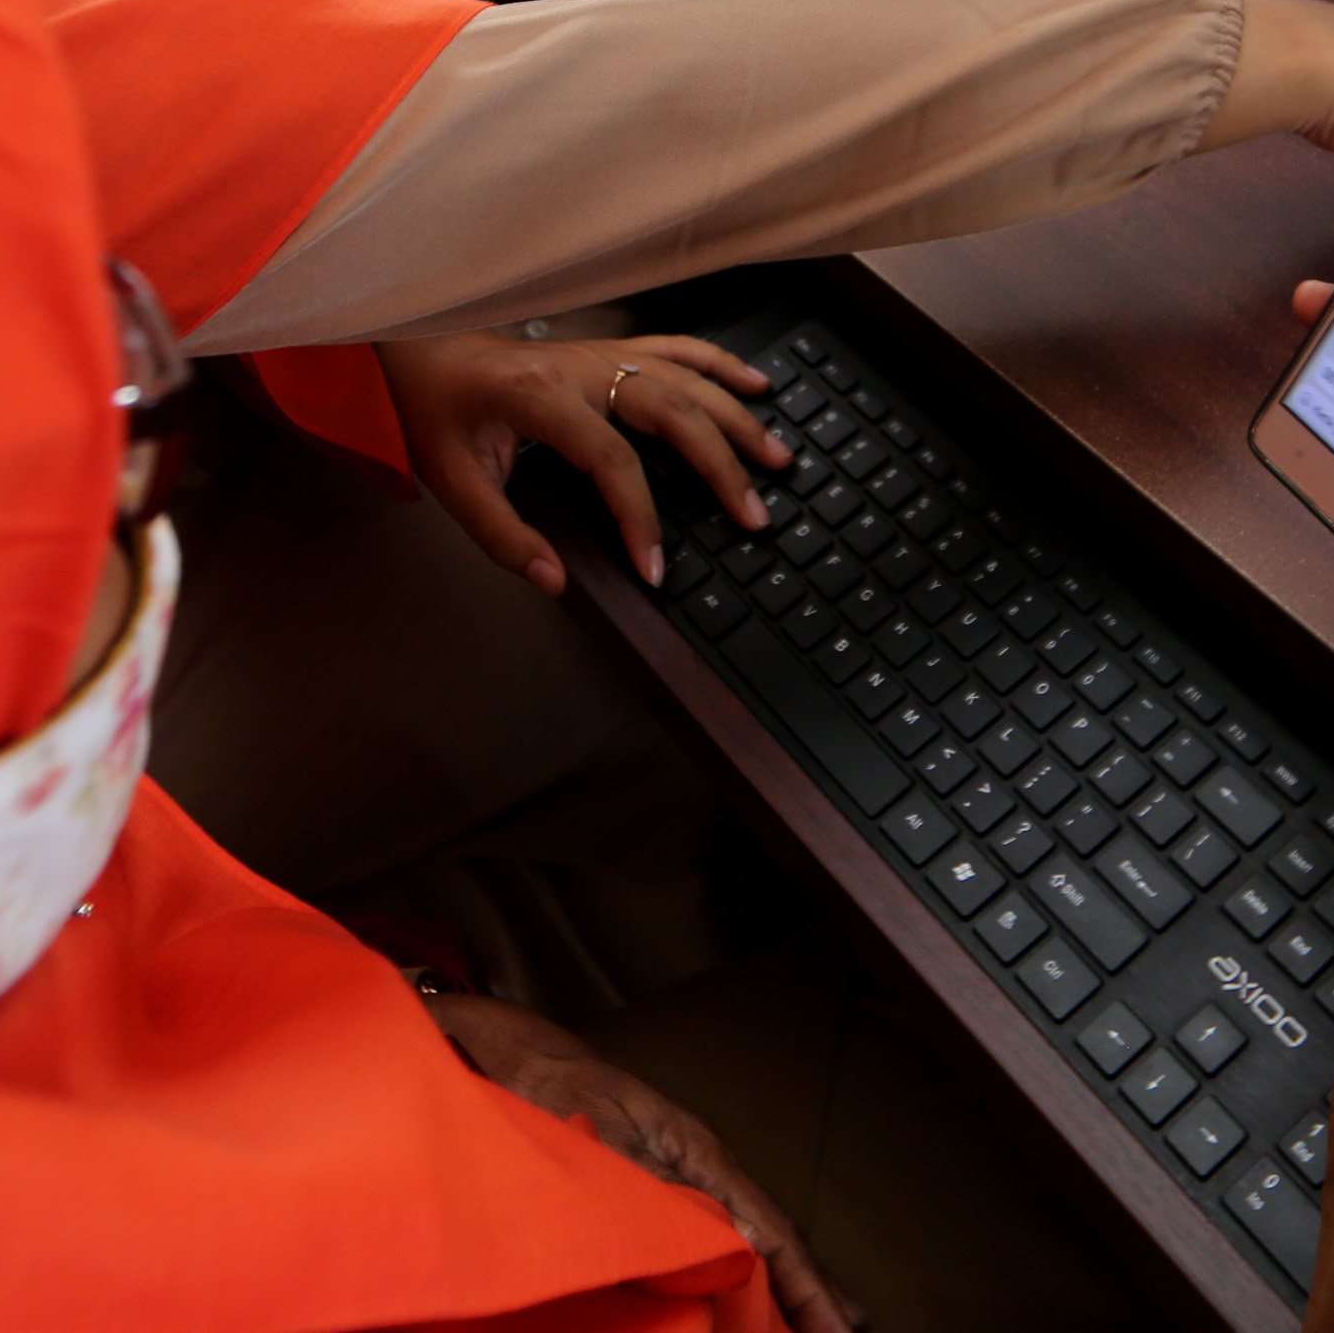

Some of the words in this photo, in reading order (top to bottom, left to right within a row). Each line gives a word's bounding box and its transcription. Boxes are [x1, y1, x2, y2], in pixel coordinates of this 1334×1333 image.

[799, 456, 816, 470] W
[828, 485, 844, 499] E
[860, 515, 875, 529] R
[795, 524, 811, 537] D
[739, 542, 755, 555] X
[895, 547, 909, 559] T
[826, 555, 842, 566] F
[770, 573, 786, 585] C
[928, 578, 942, 592] Y
[859, 589, 875, 602] G
[803, 604, 818, 617] V
[962, 612, 978, 626] U
[893, 621, 910, 636] H
[833, 638, 850, 653] B
[997, 646, 1010, 657] I
[926, 657, 942, 667] J
[1143, 648, 1161, 664] F10
[868, 672, 886, 687] N
[1034, 681, 1050, 695] O
[1184, 686, 1202, 702] F11
[965, 691, 980, 706] K
[902, 709, 921, 726] M
[1071, 717, 1089, 729] P
[1000, 727, 1014, 742] L
[1227, 724, 1248, 742] F12
[905, 813, 924, 830] Alt
[1287, 849, 1316, 873] Insert
[1118, 860, 1143, 882] Enter
[1060, 882, 1086, 907] Shift
[1242, 889, 1269, 916] Delete
[1288, 935, 1314, 957] End
[1042, 959, 1066, 981] Ctrl
[1207, 956, 1308, 1048] axioo
[1308, 1123, 1326, 1137] 1
[1290, 1140, 1316, 1163] End
[1262, 1173, 1282, 1190] 0
